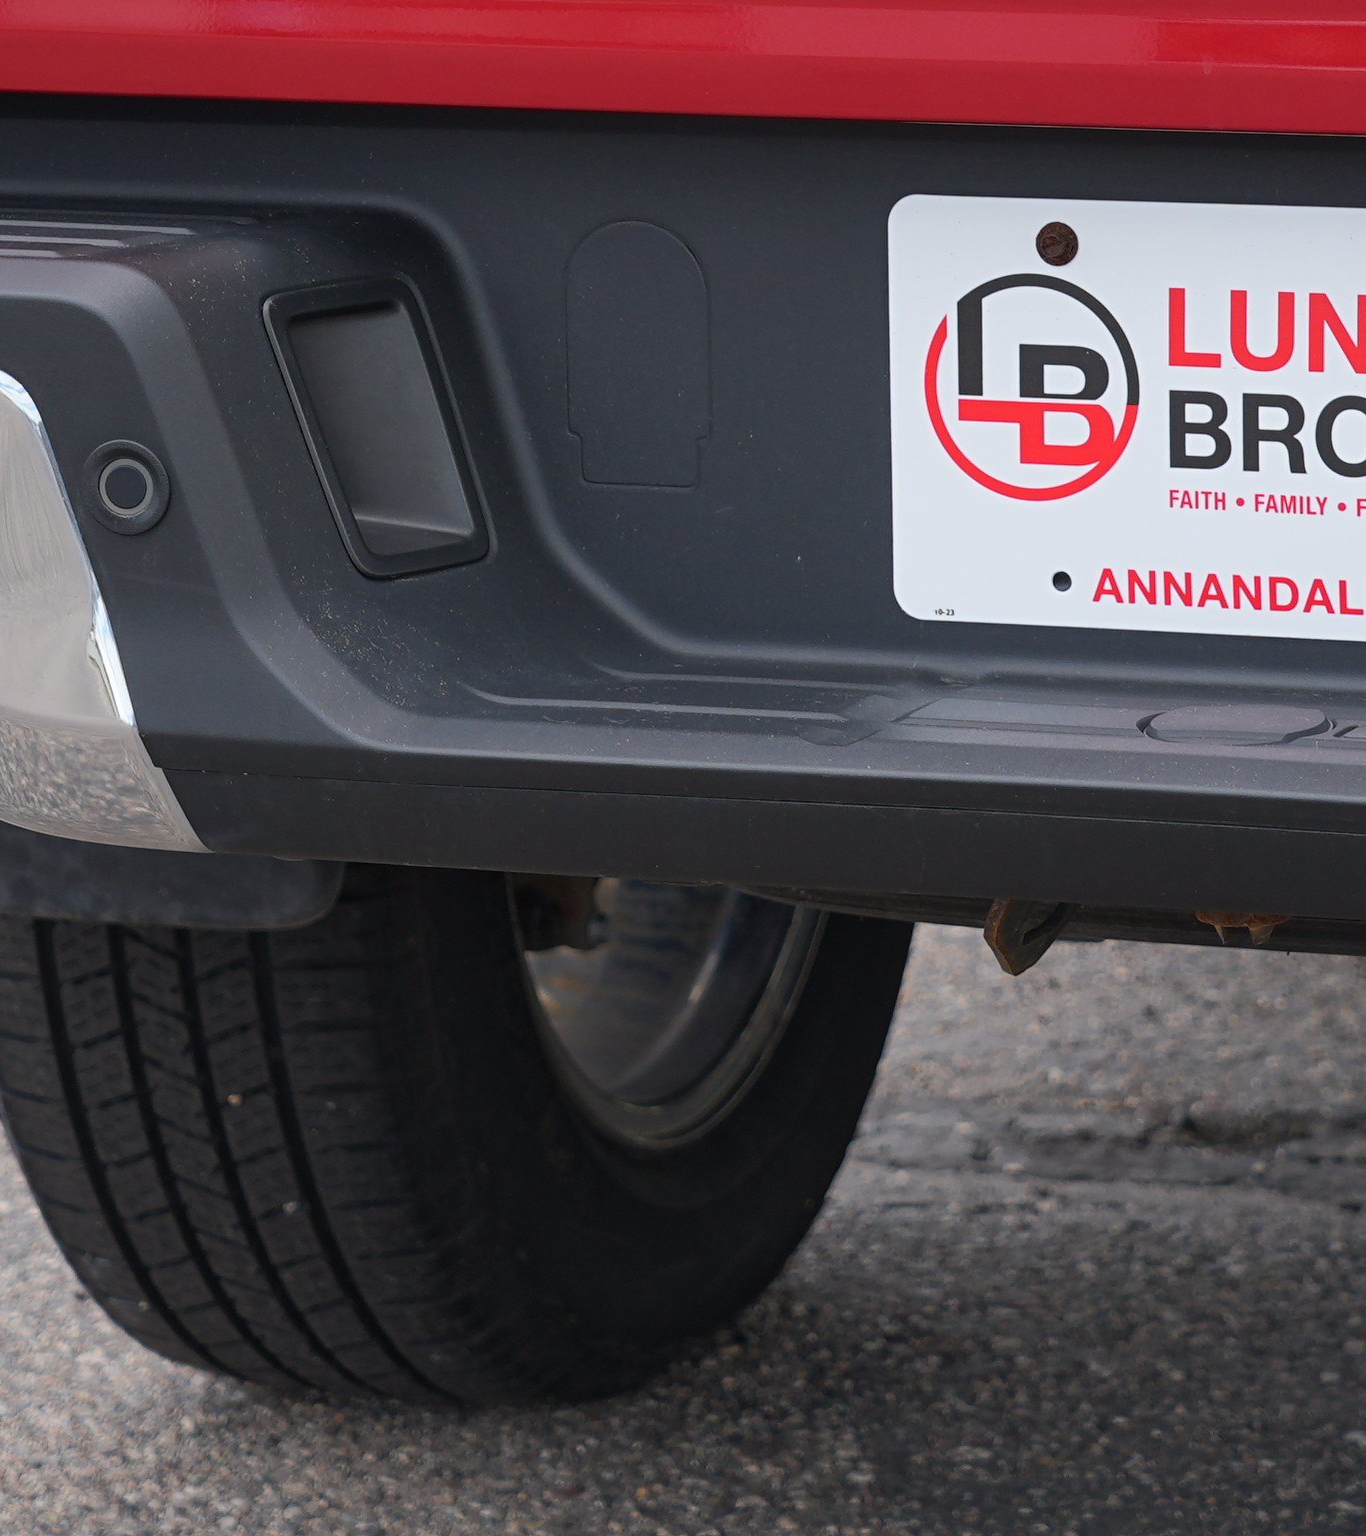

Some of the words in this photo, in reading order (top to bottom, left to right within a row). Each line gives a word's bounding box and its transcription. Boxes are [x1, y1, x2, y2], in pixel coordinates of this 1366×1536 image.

[1169, 489, 1226, 512] FAITH
[1254, 493, 1328, 517] FAMILY
[934, 608, 955, 616] 10-23
